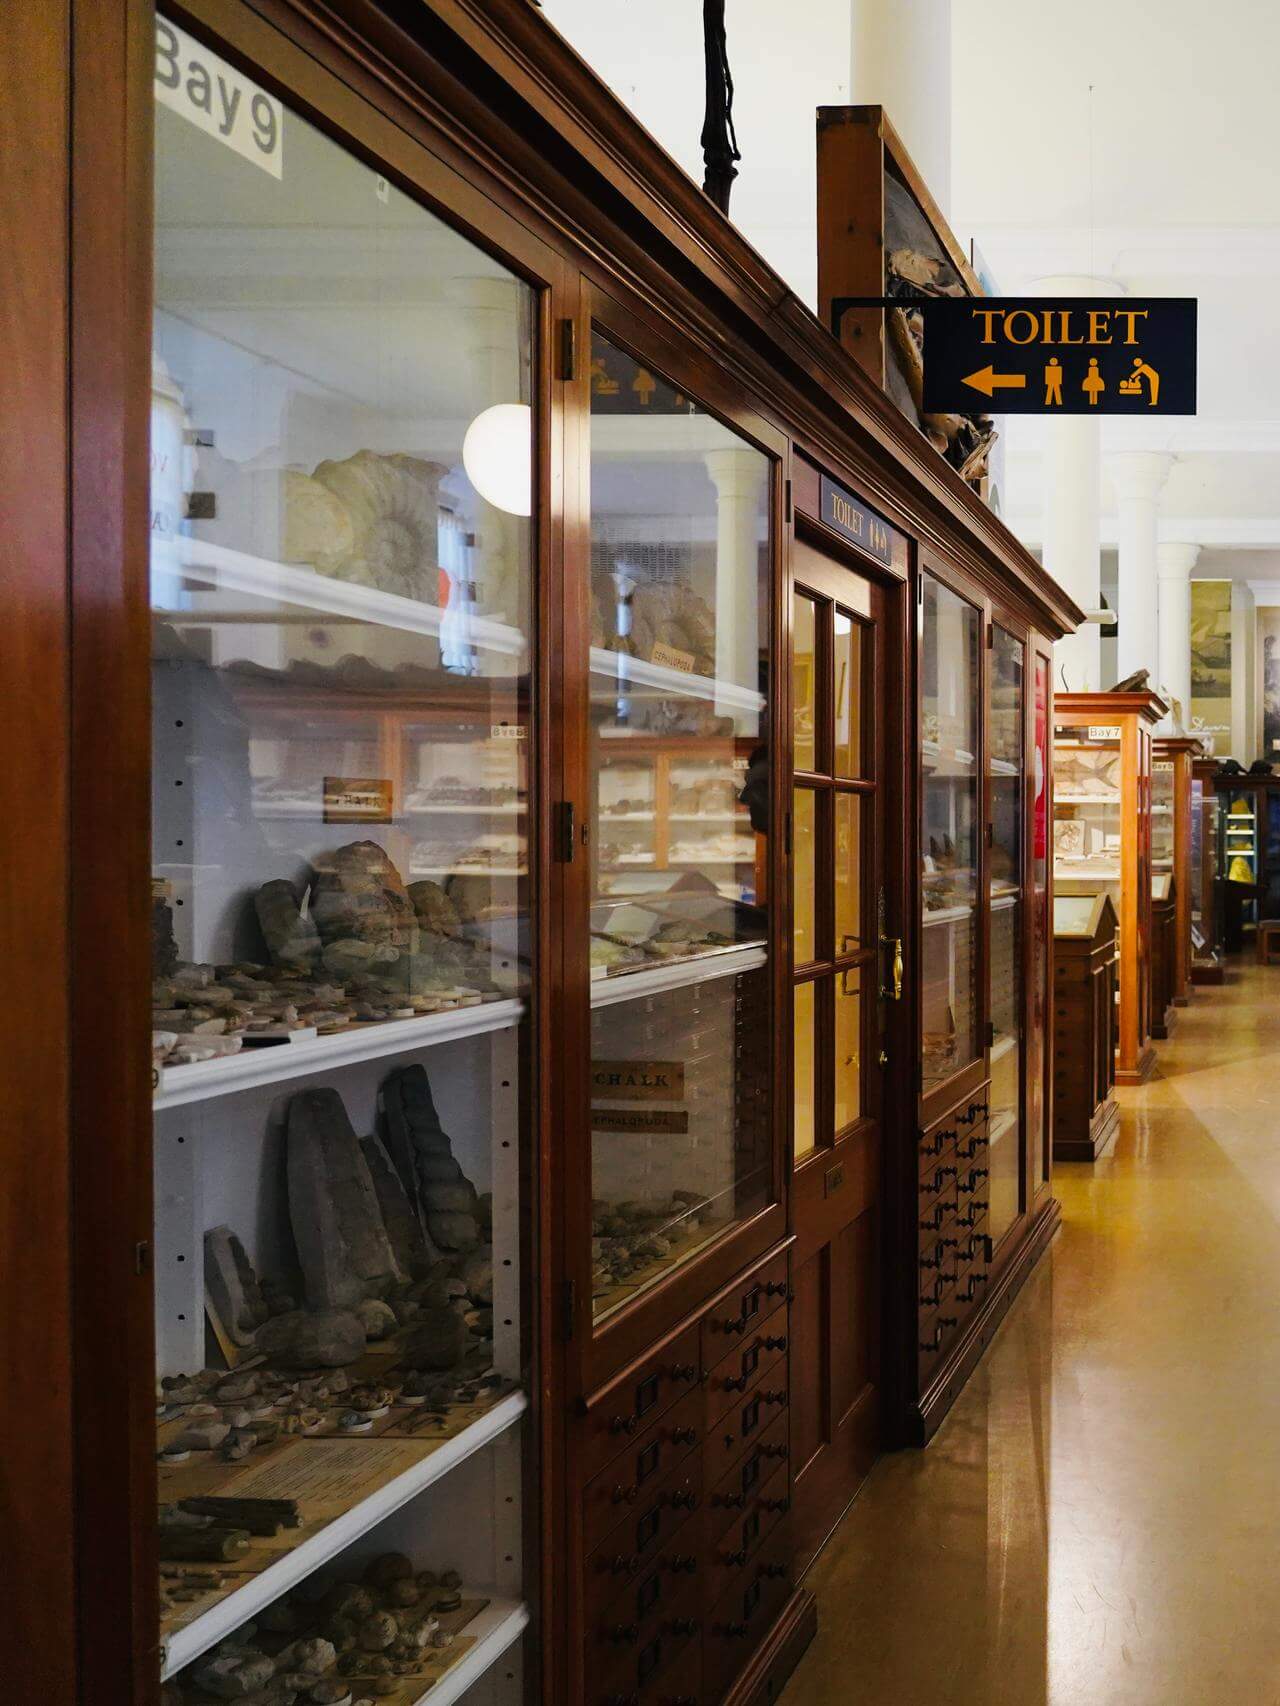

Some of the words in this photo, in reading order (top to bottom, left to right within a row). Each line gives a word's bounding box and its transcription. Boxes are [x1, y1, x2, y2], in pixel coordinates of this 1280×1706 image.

[155, 19, 241, 137] Bay
[251, 93, 277, 154] 9
[972, 310, 1148, 345] TOILET
[831, 492, 864, 537] TOILET
[1089, 728, 1112, 738] Bay
[1114, 728, 1121, 737] 7
[594, 1072, 670, 1087] CHALK
[592, 1116, 670, 1127] EPHALOPODA
